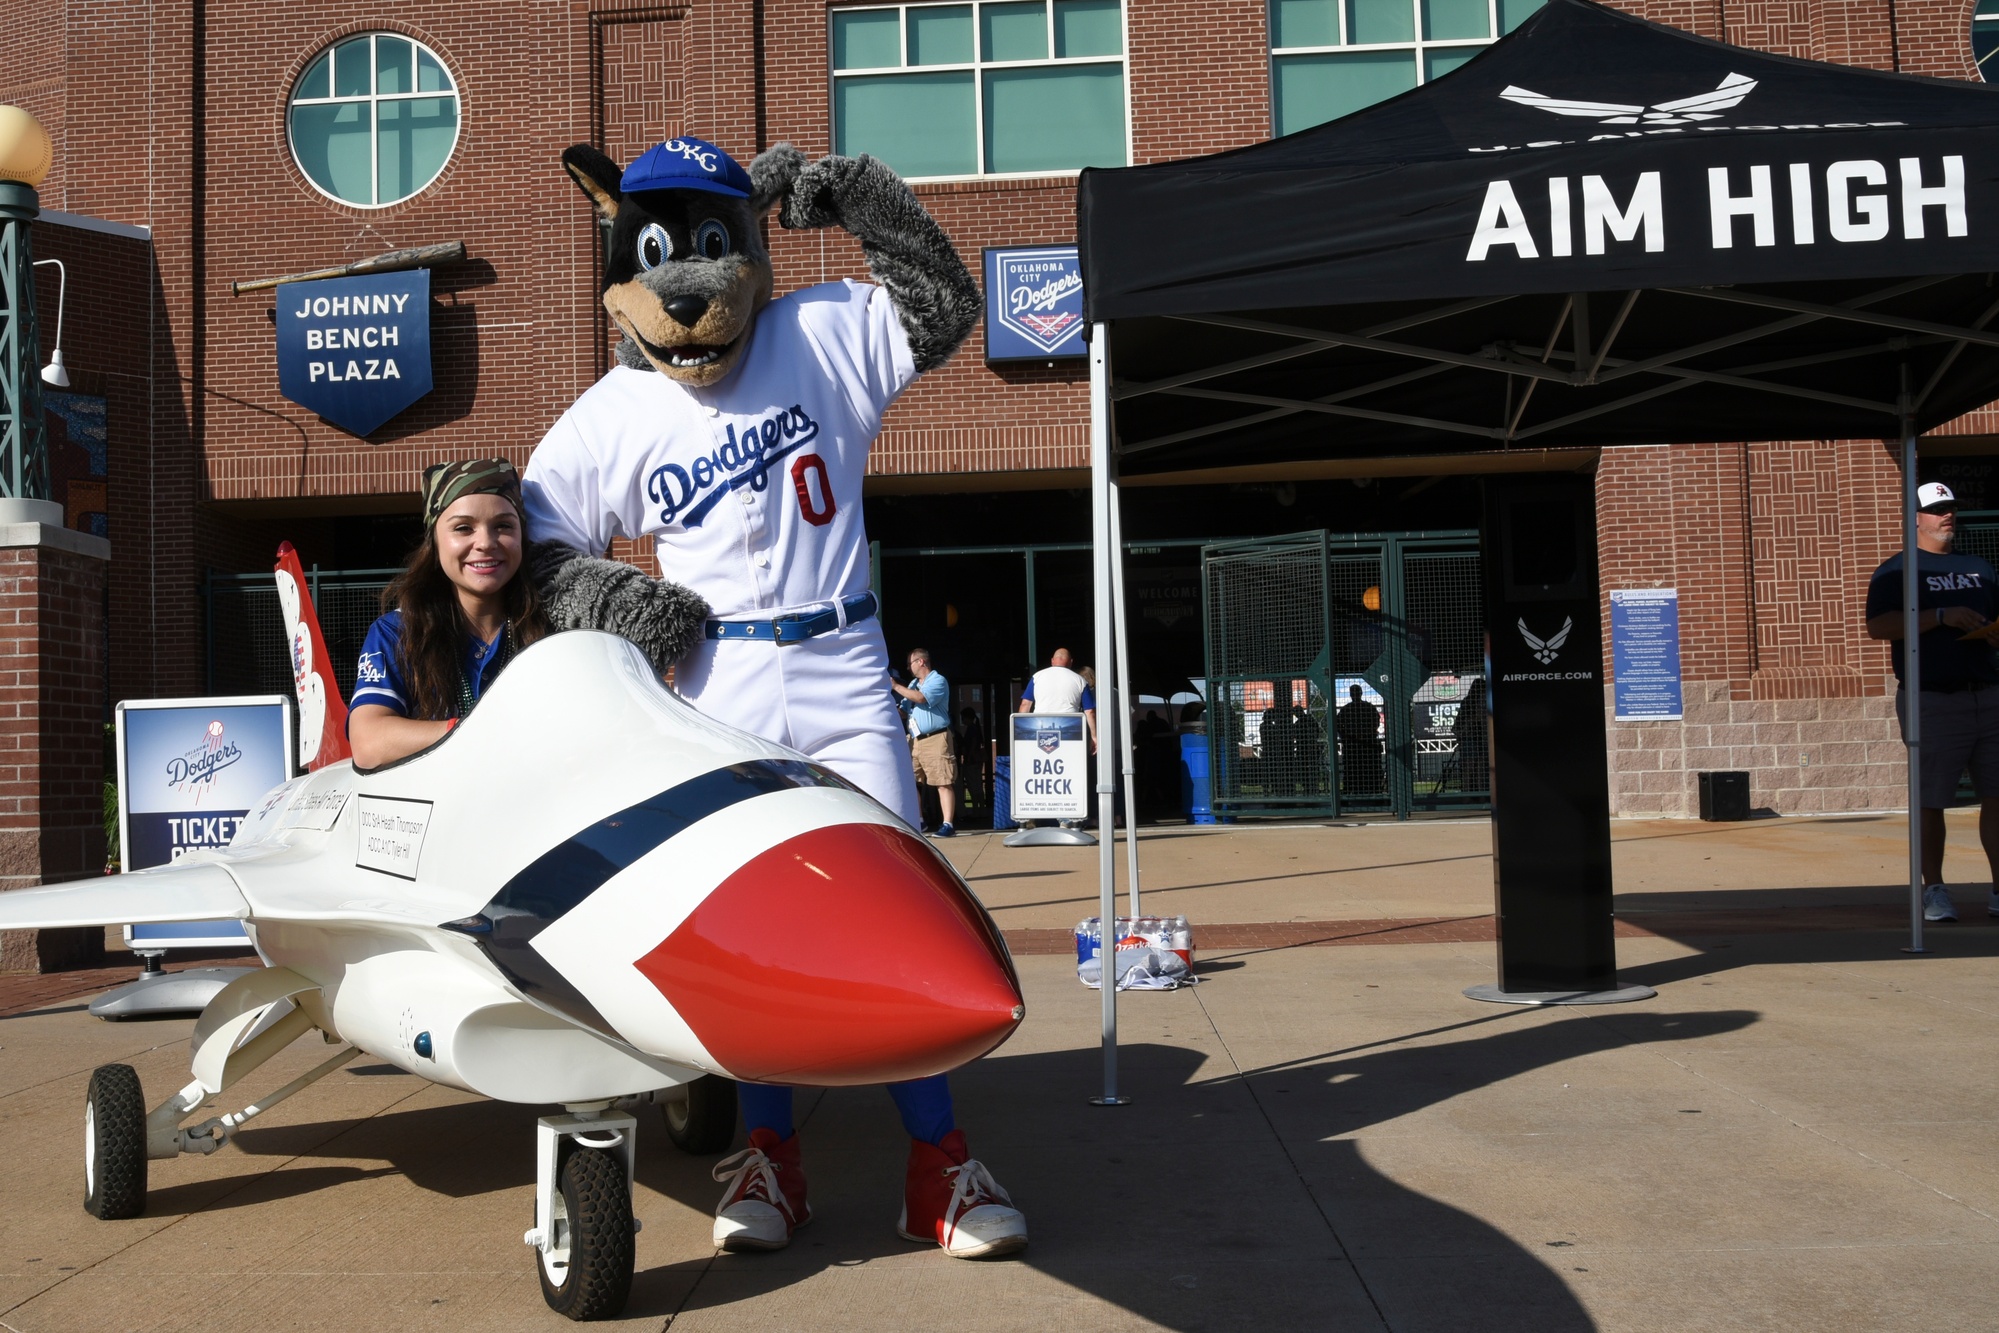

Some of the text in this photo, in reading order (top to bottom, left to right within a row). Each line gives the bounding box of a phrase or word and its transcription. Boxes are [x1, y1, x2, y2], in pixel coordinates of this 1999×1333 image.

[665, 139, 717, 172] OKC
[1466, 155, 1968, 261] AIM HIGH
[1010, 262, 1064, 273] OKLAHOMA
[1019, 273, 1041, 283] CITY
[1011, 270, 1083, 314] Dodgers
[295, 293, 410, 318] JOHNNY
[306, 326, 399, 350] BENCH
[309, 358, 401, 383] PLAZA
[648, 404, 819, 530] Dodgers
[1939, 464, 1992, 477] GROUP
[790, 453, 837, 527] 0
[1926, 572, 1982, 592] SWAT
[1138, 587, 1198, 599] WELCOME
[1502, 671, 1593, 682] AIRFORCE.COM
[1432, 716, 1455, 727] Sha
[184, 743, 210, 758] OKLAHOMA
[189, 752, 201, 760] CITY
[166, 740, 242, 787] Dodgers
[1033, 759, 1064, 775] BAG
[1025, 779, 1072, 795] CHECK
[168, 816, 246, 845] TICKET
[380, 814, 395, 831] Heath
[396, 816, 423, 837] Thompson
[392, 841, 402, 860] Tyler
[402, 843, 411, 859] Hill
[1115, 940, 1151, 952] Ozarka
